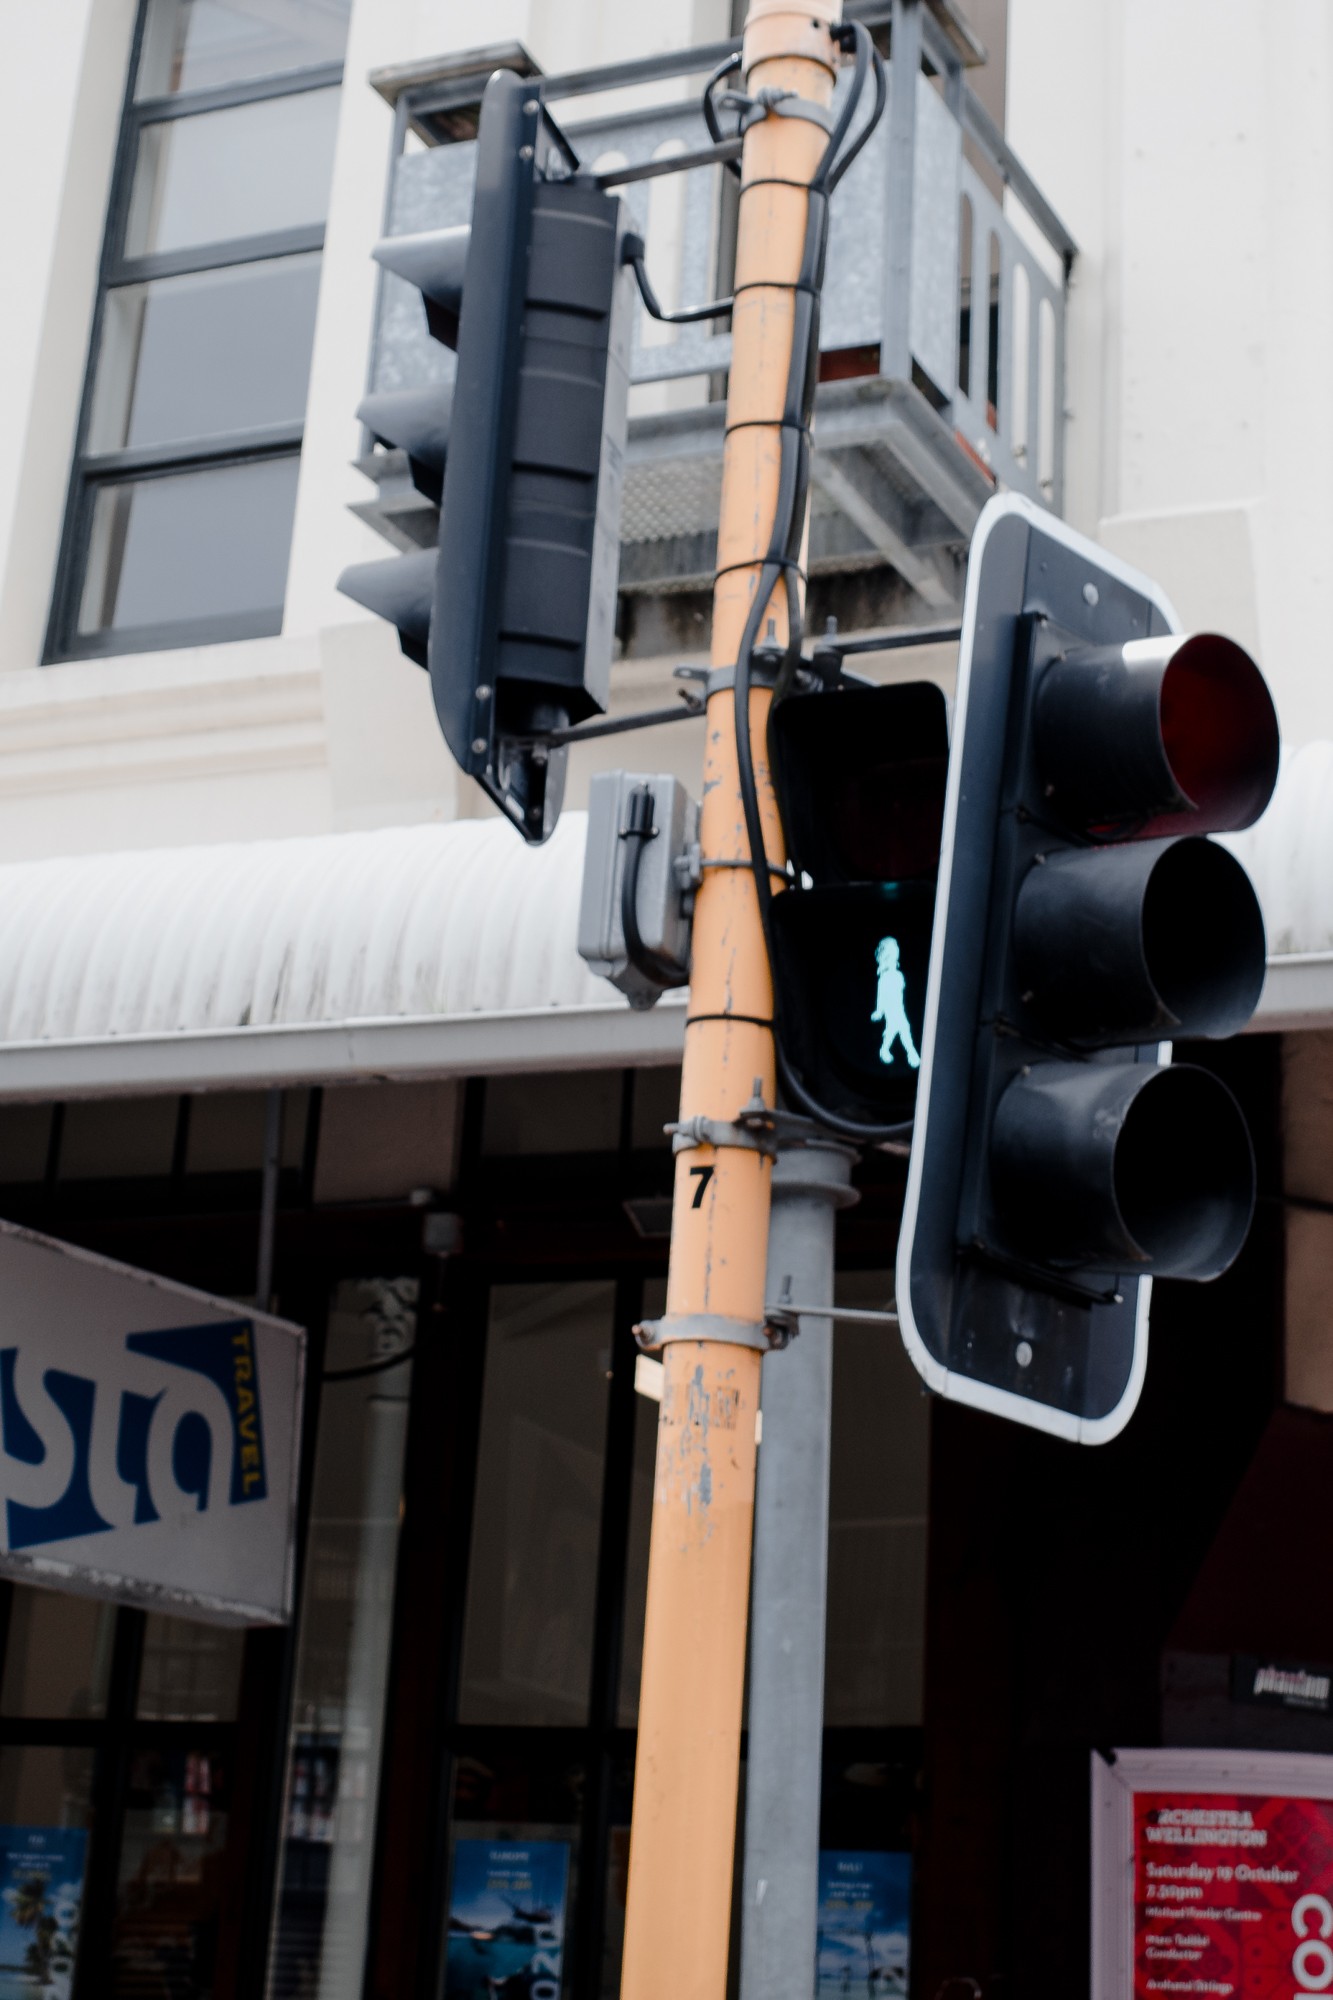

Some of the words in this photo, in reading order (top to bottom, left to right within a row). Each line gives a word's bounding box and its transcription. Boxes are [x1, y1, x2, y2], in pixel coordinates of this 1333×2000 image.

[689, 1166, 715, 1209] 7
[231, 1328, 261, 1496] TRAVEL
[1145, 1826, 1269, 1848] WELLINGTON
[1145, 1862, 1215, 1883] Saturday
[1234, 1864, 1300, 1884] October
[1291, 1893, 1333, 2000] CO
